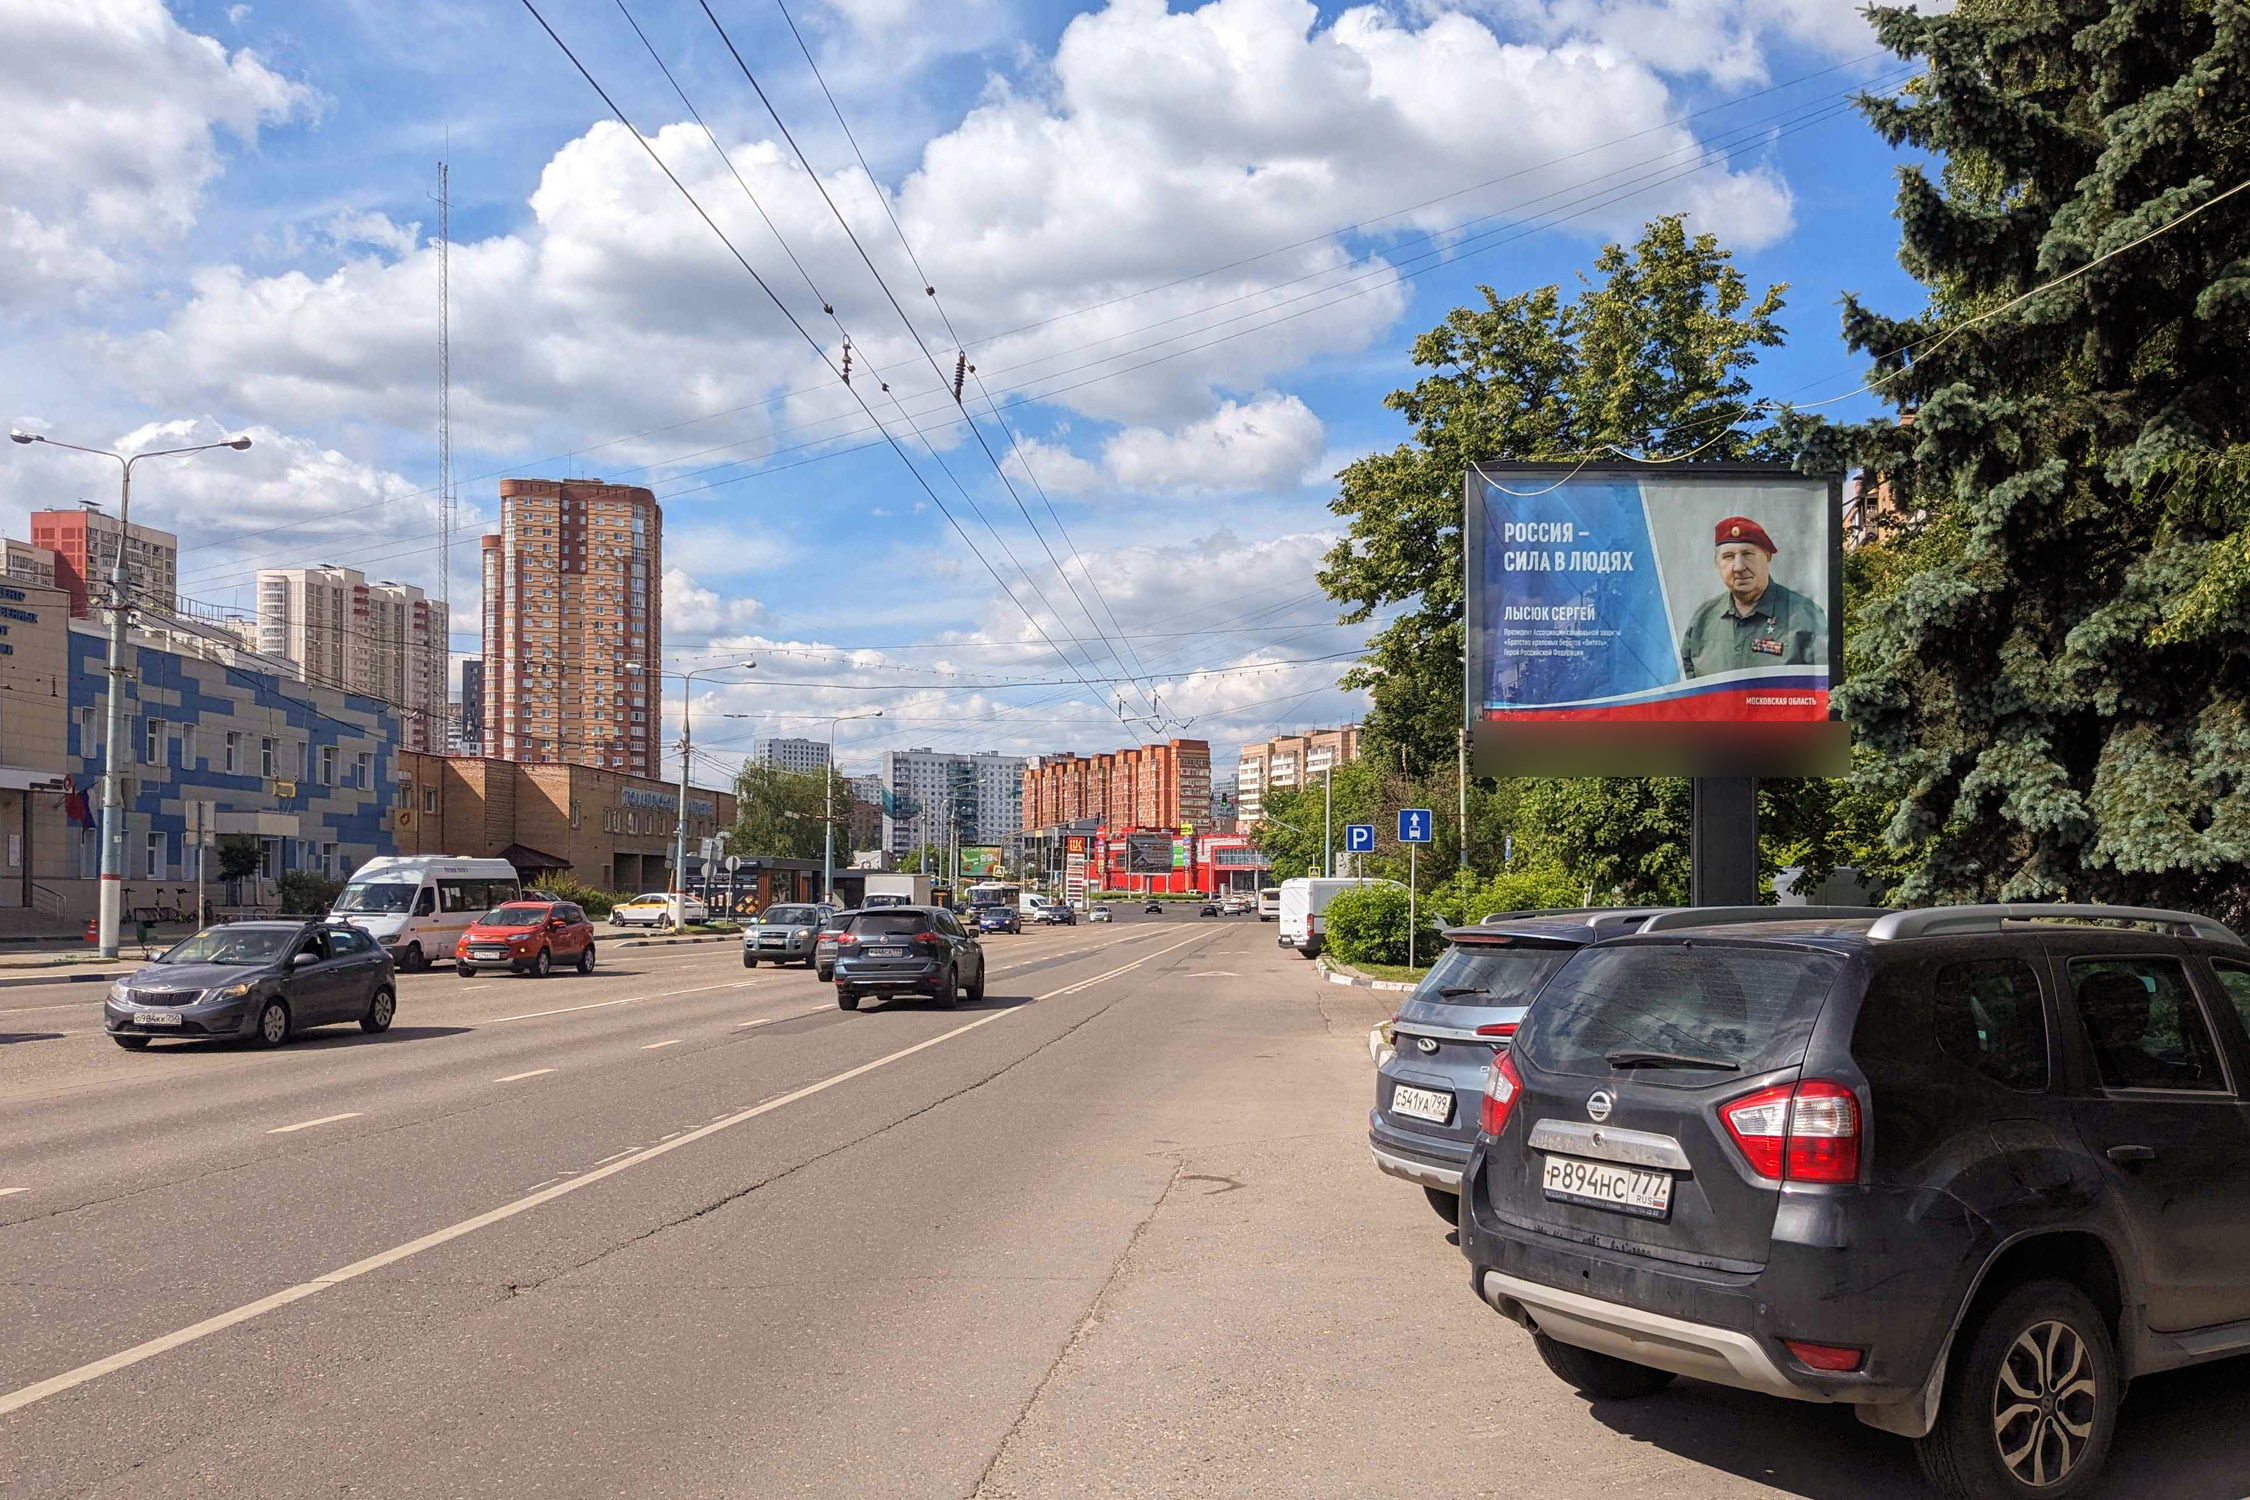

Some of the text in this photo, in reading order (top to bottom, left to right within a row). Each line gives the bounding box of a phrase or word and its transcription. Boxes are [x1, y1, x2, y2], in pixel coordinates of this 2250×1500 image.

[1504, 522, 1573, 542] РОССИЯ
[1504, 551, 1634, 573] СИЛА В ЛЮДЯХ
[1504, 604, 1595, 620] ЛЫСЮК СЕРГЕЙ
[1504, 648, 1519, 657] Герой
[1520, 648, 1552, 657] Российской
[1746, 697, 1817, 705] МОСКОВСКАЯ ОБЛАСТЬ
[1353, 828, 1368, 849] P
[1631, 1171, 1665, 1197] 777
[1636, 1194, 1653, 1206] RUS
